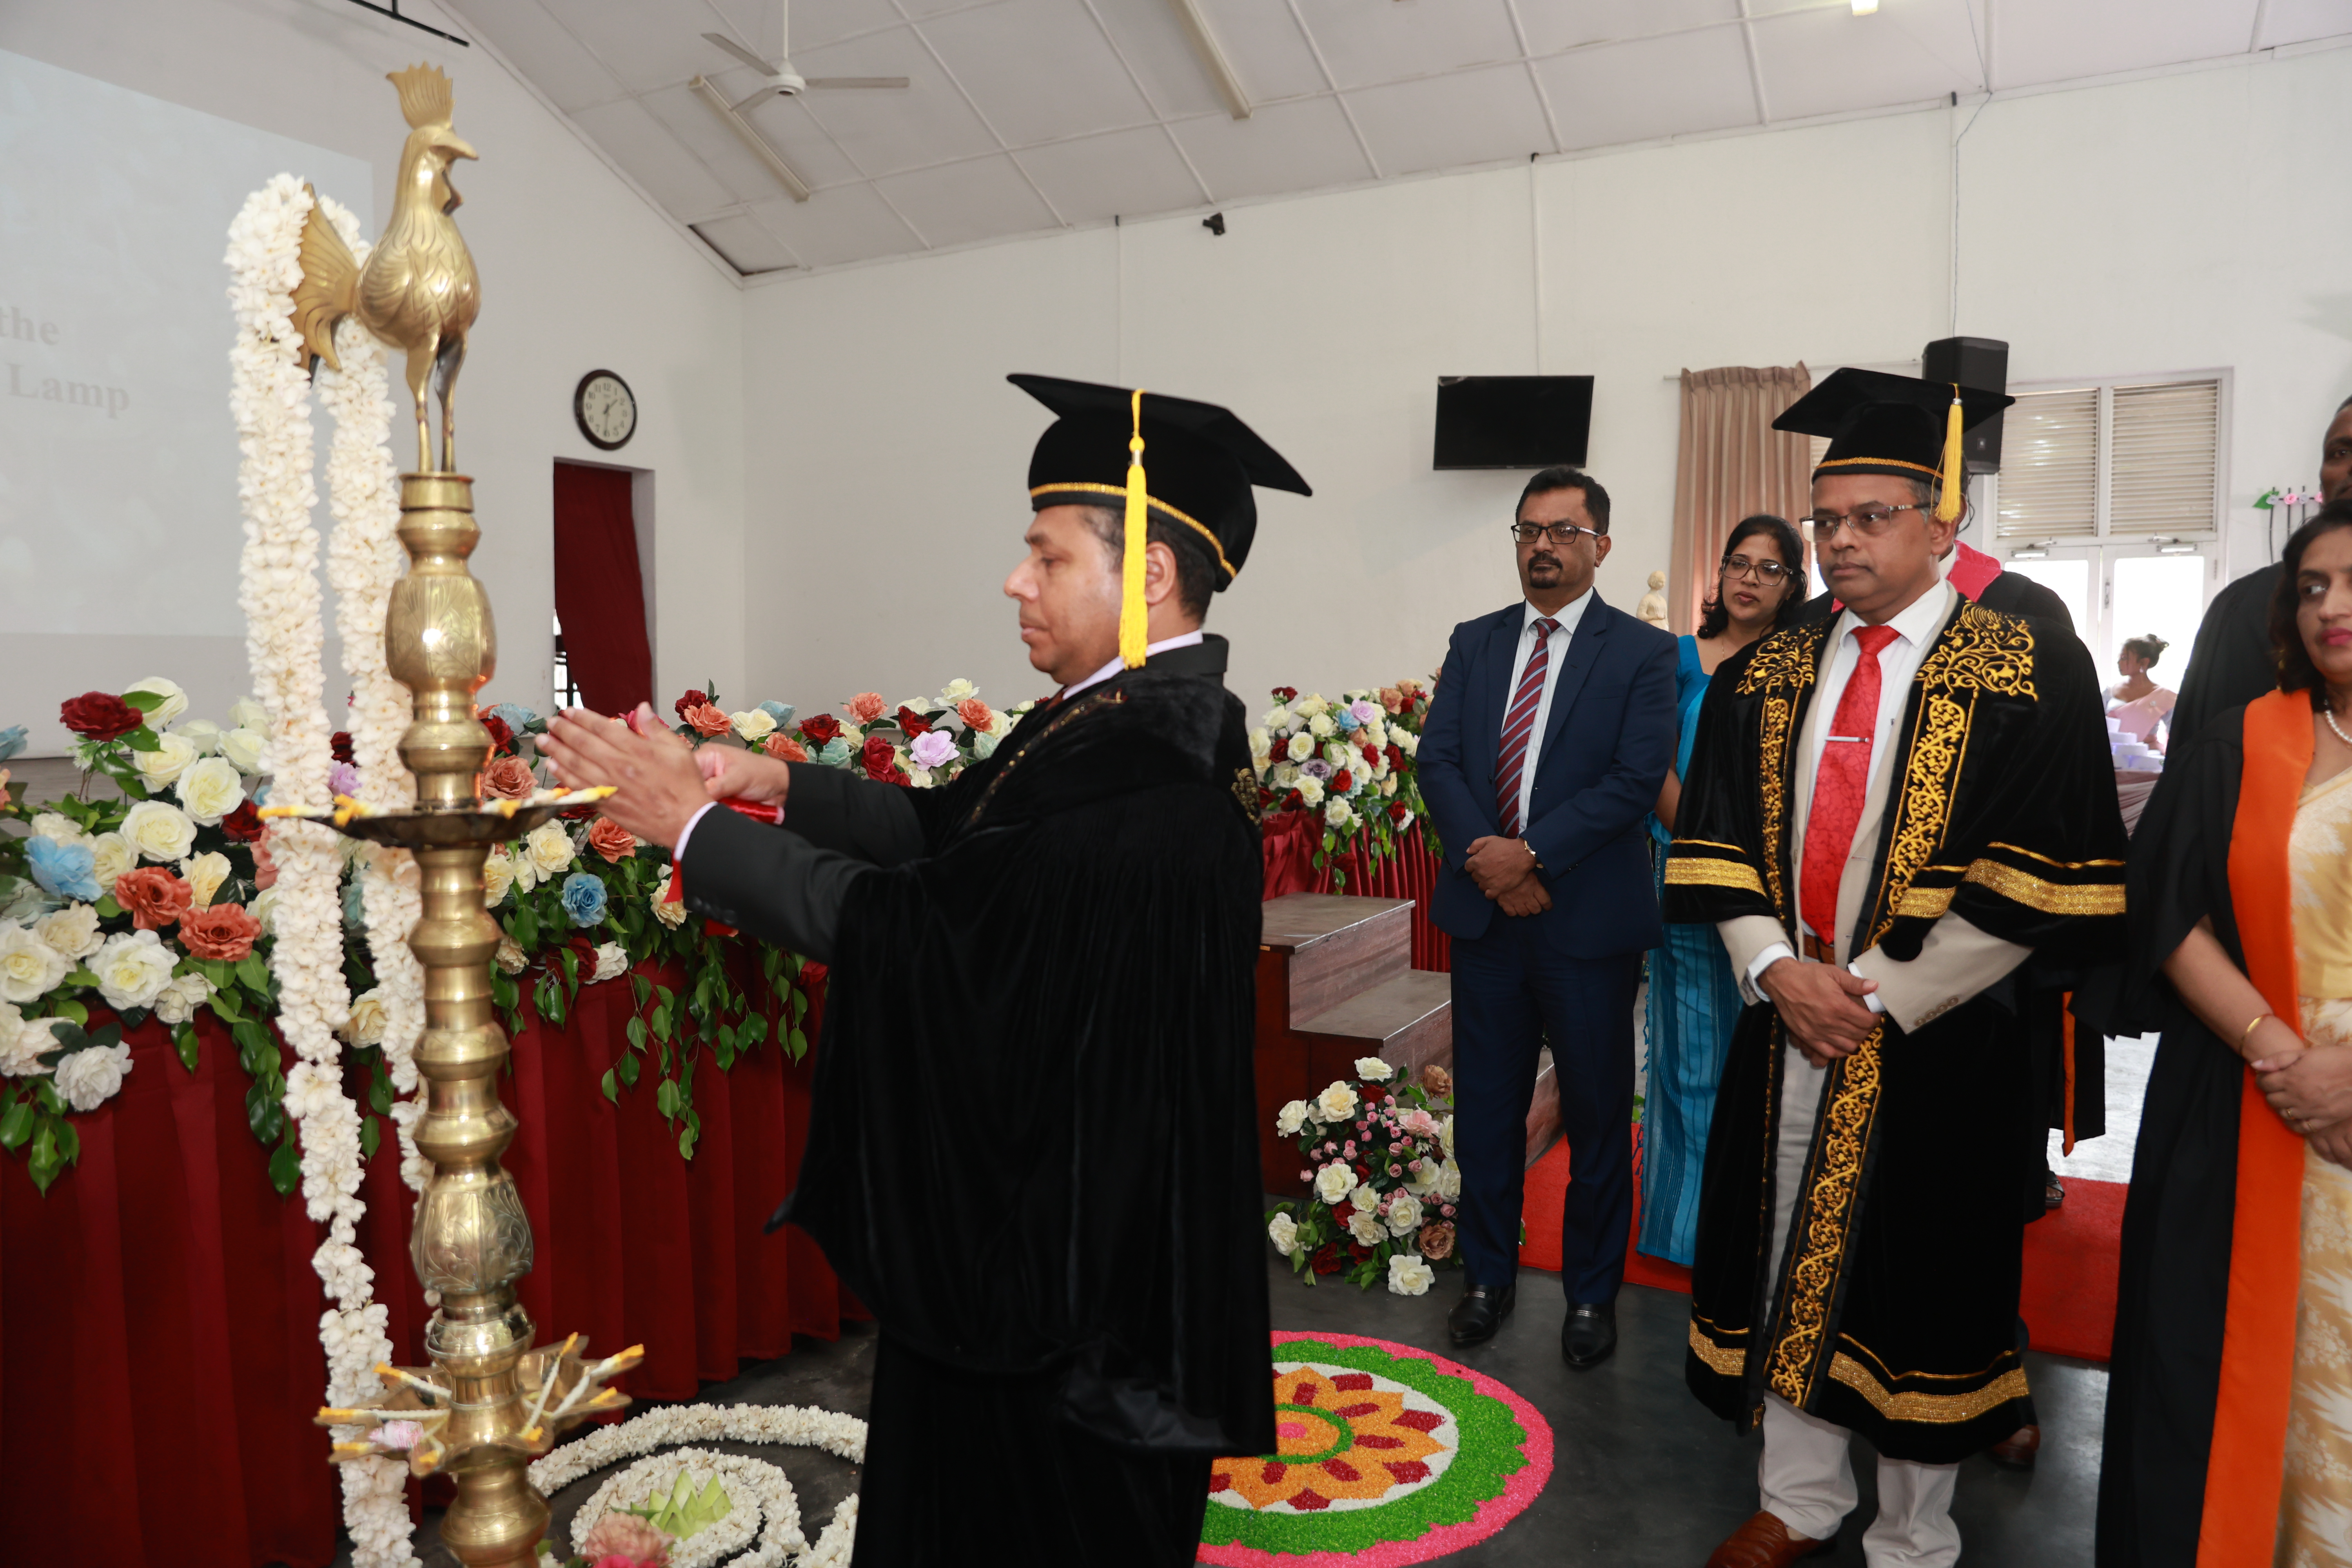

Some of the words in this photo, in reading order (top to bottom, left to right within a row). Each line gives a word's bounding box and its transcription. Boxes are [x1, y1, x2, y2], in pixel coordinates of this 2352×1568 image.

[0, 307, 60, 345] the
[595, 384, 601, 392] 11
[603, 383, 611, 391] 12
[6, 363, 130, 420] Lamp
[614, 387, 617, 396] 1
[620, 397, 625, 405] 2
[586, 402, 592, 410] 9
[595, 424, 600, 432] 7
[619, 420, 624, 428] 4
[613, 426, 619, 436] 5
